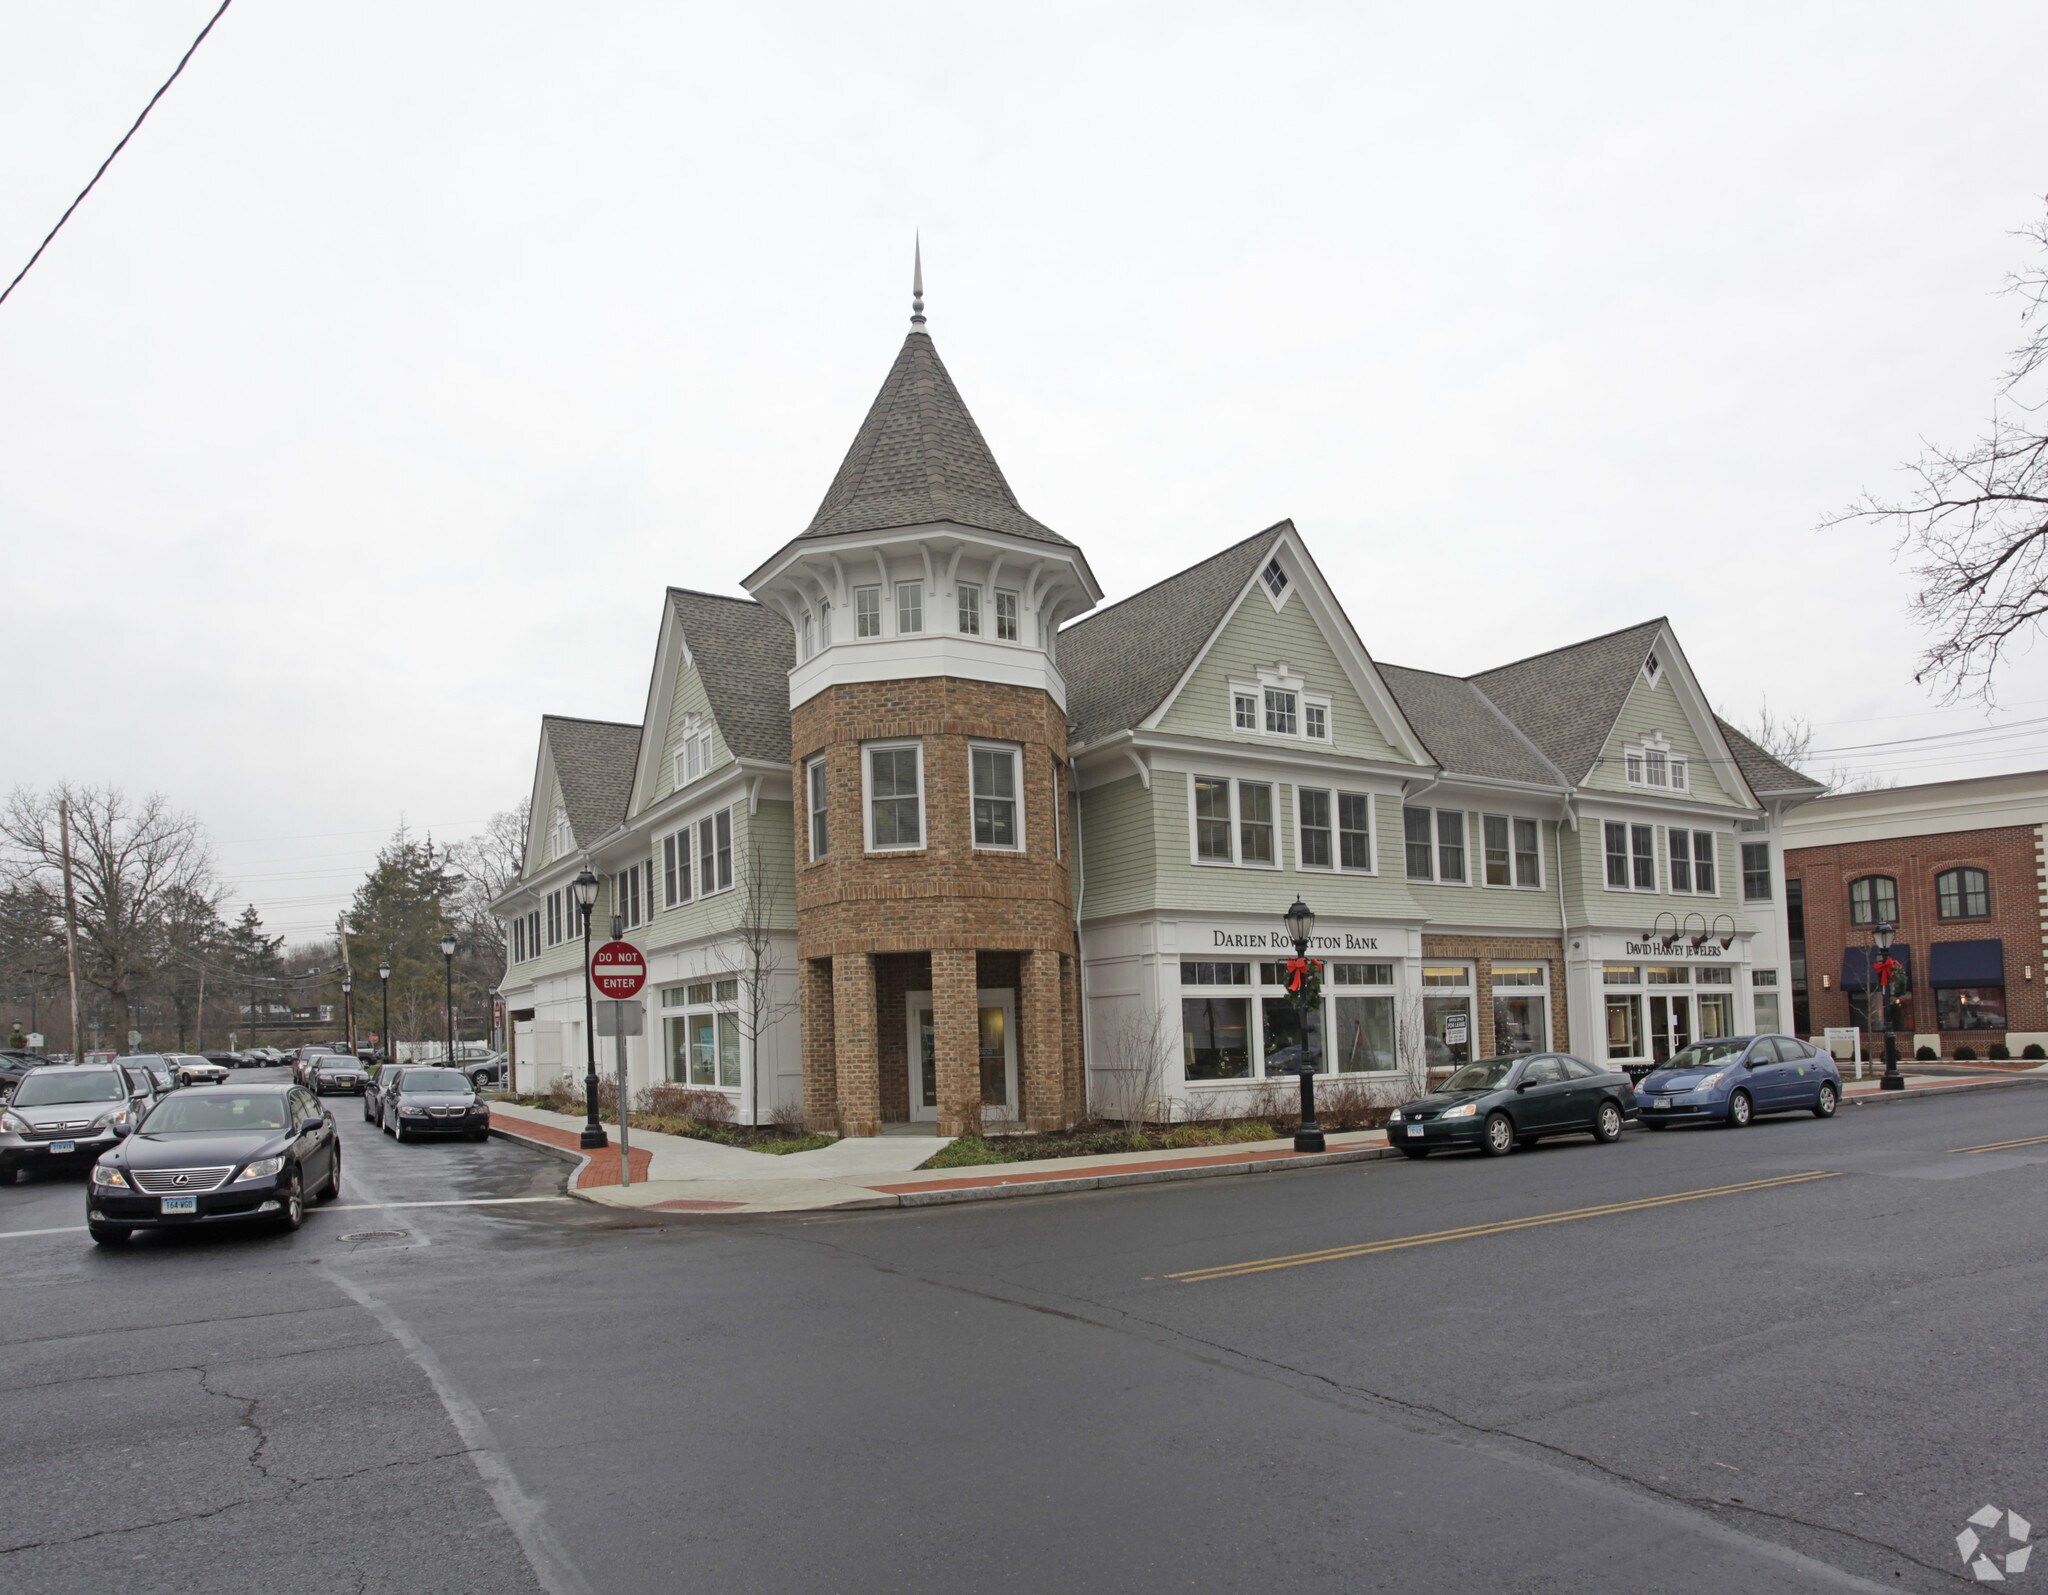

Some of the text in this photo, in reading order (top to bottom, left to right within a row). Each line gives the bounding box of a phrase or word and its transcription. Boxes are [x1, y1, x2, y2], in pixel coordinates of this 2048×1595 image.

[1270, 932, 1341, 949] ROYTON
[1345, 934, 1378, 950] BANK
[1626, 941, 1652, 955] DAVID
[598, 952, 638, 962] DO NOT
[603, 978, 636, 989] ENTER
